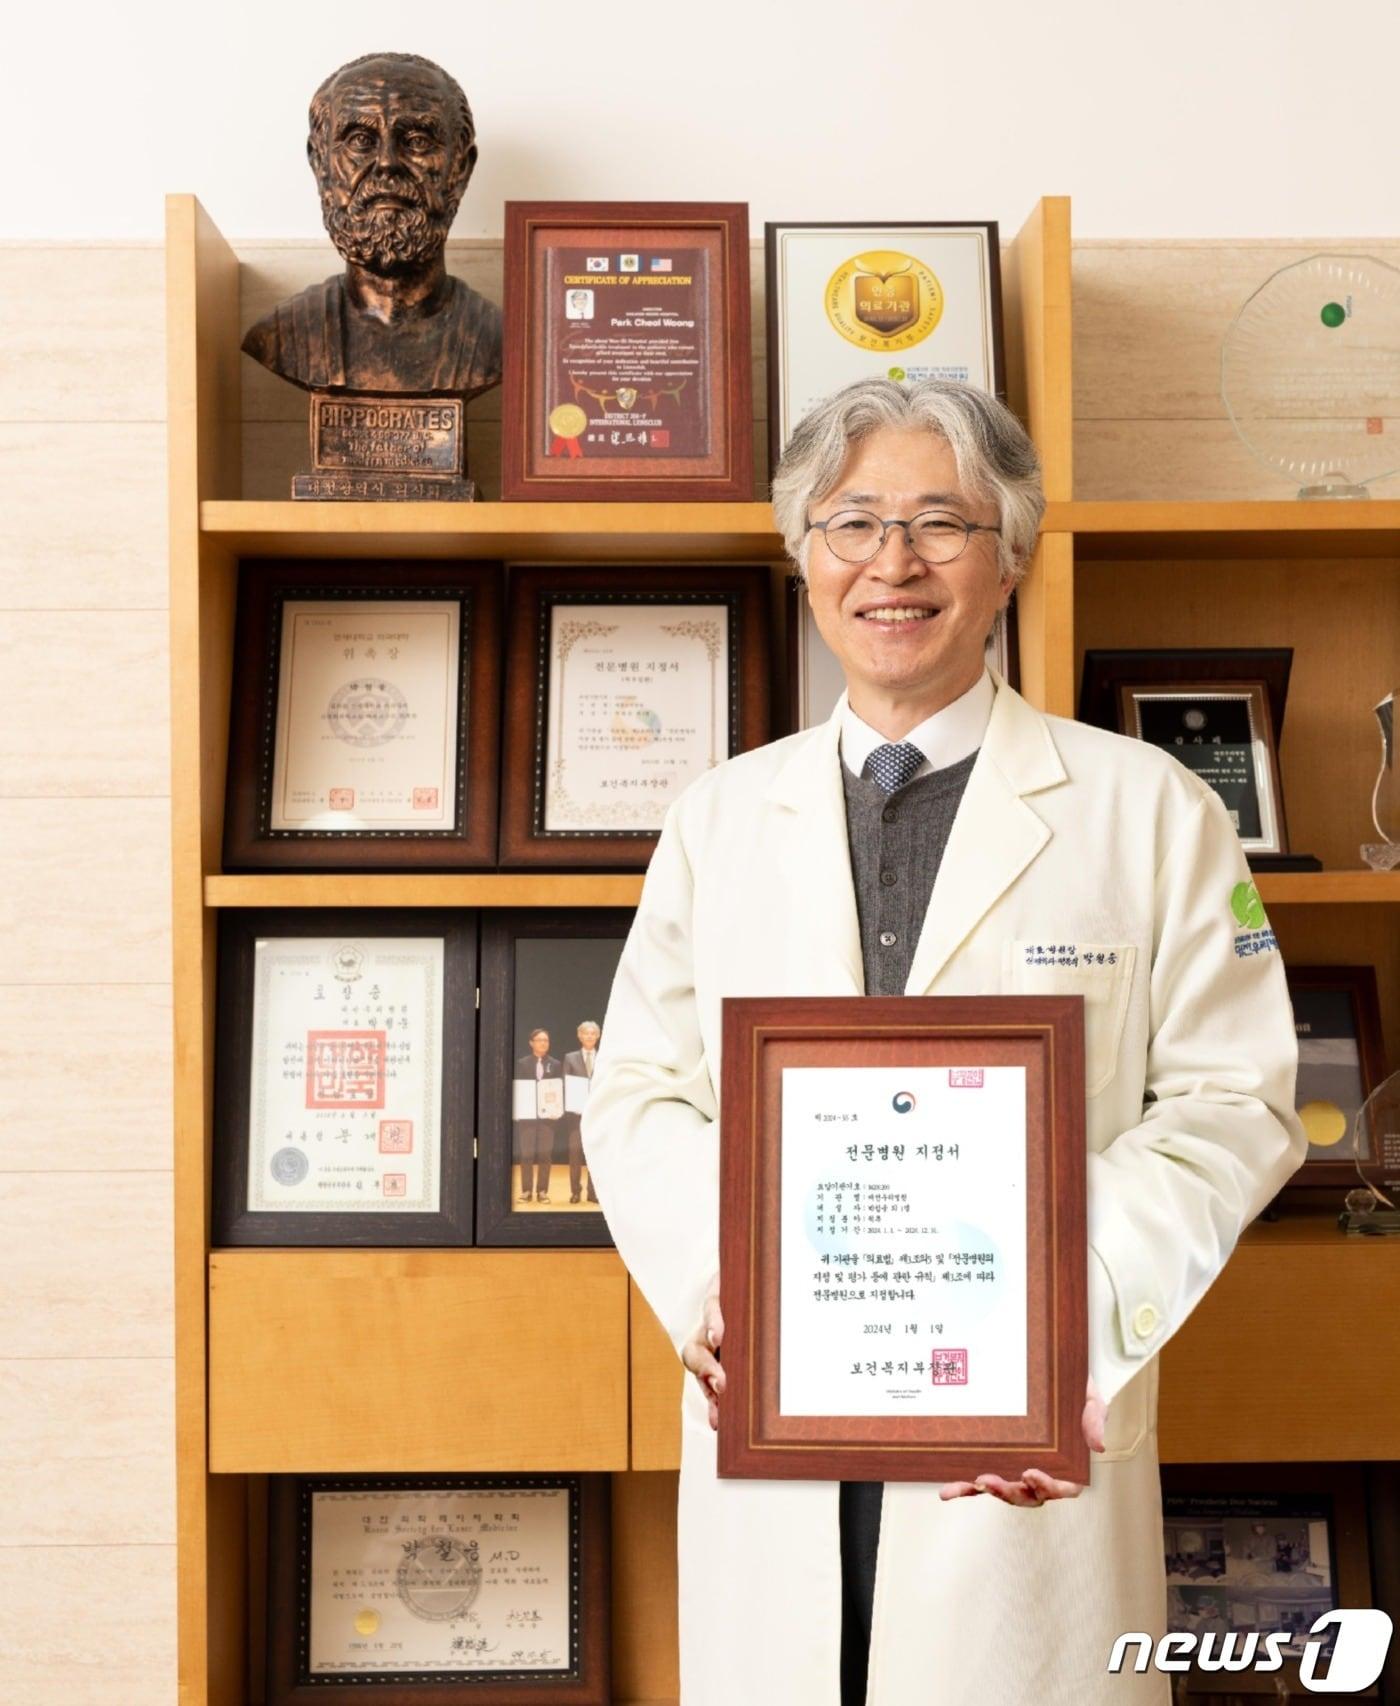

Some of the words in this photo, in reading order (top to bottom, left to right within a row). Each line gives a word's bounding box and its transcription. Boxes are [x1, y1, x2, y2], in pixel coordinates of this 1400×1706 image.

[564, 276, 618, 286] CERTIFICATE
[618, 276, 630, 286] OF
[632, 276, 692, 286] APPRECIATION
[918, 271, 937, 302] PATIENT
[860, 301, 911, 312] 의료기관
[611, 318, 632, 327] Park
[663, 318, 695, 328] Woong
[321, 406, 454, 430] HIPPOCRATES
[413, 441, 427, 453] of
[594, 662, 640, 672] 전문병원
[646, 662, 680, 672] 지정서
[846, 1144, 906, 1162] 전문병원
[915, 1143, 960, 1161] 지정서
[833, 1253, 860, 1265] 기관을
[936, 1252, 944, 1265] 및
[813, 1271, 830, 1283] 지정
[834, 1271, 844, 1283] 및
[976, 1270, 996, 1282] 따라
[813, 1289, 866, 1302] 전문병원으로
[863, 1324, 892, 1335] 2024년
[904, 1324, 918, 1335] 1월
[930, 1324, 944, 1335] 1일
[850, 1362, 958, 1377] 보건복지부장관
